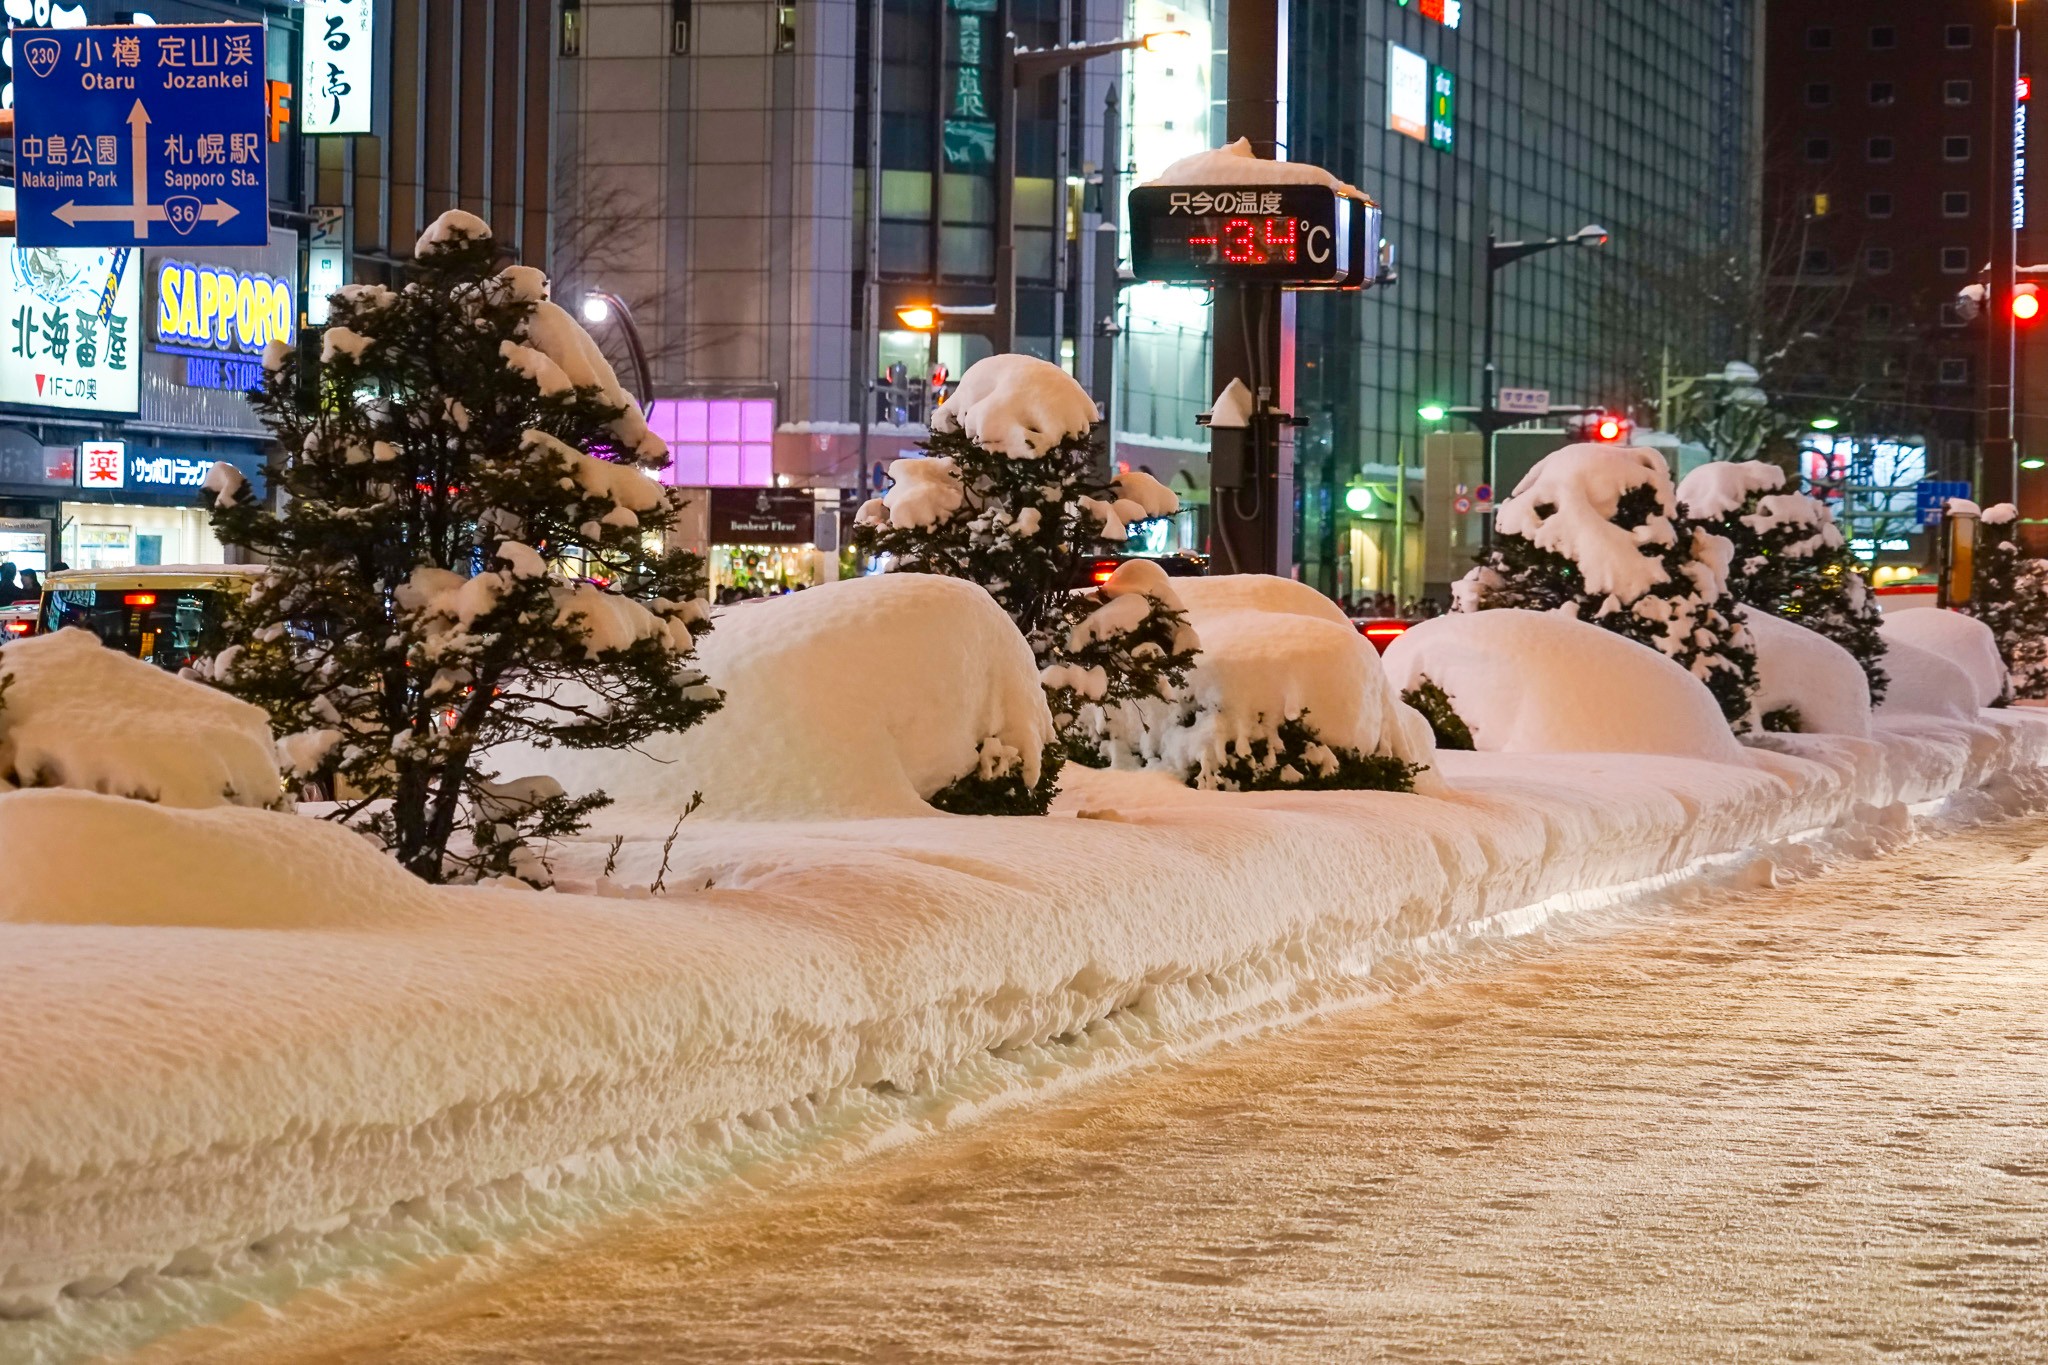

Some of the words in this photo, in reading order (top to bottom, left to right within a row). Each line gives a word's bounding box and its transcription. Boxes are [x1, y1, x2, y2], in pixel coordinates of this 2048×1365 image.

[31, 47, 55, 64] 230
[75, 36, 141, 68] 小樽
[157, 34, 253, 67] 定山渓
[82, 72, 135, 90] Otaru
[163, 71, 248, 89] Jozankei
[22, 134, 117, 165] 中島公園
[164, 133, 260, 165] 札幌駅
[22, 171, 83, 191] Nakajima
[88, 171, 118, 187] Park
[165, 169, 225, 190] Sapporo
[231, 169, 259, 186] Sta.
[172, 205, 194, 222] 36
[1169, 191, 1282, 215] 只今の温度
[1189, 220, 1297, 263] -3.4
[160, 264, 293, 348] SAPPORO
[12, 304, 128, 370] 北海番屋
[187, 356, 221, 389] DRUG
[49, 376, 97, 400] 1Fこの奥
[89, 449, 118, 482] 薬
[136, 456, 213, 486] サッポロドラッグ
[731, 521, 768, 532] Bonheur
[771, 521, 796, 532] Fleur
